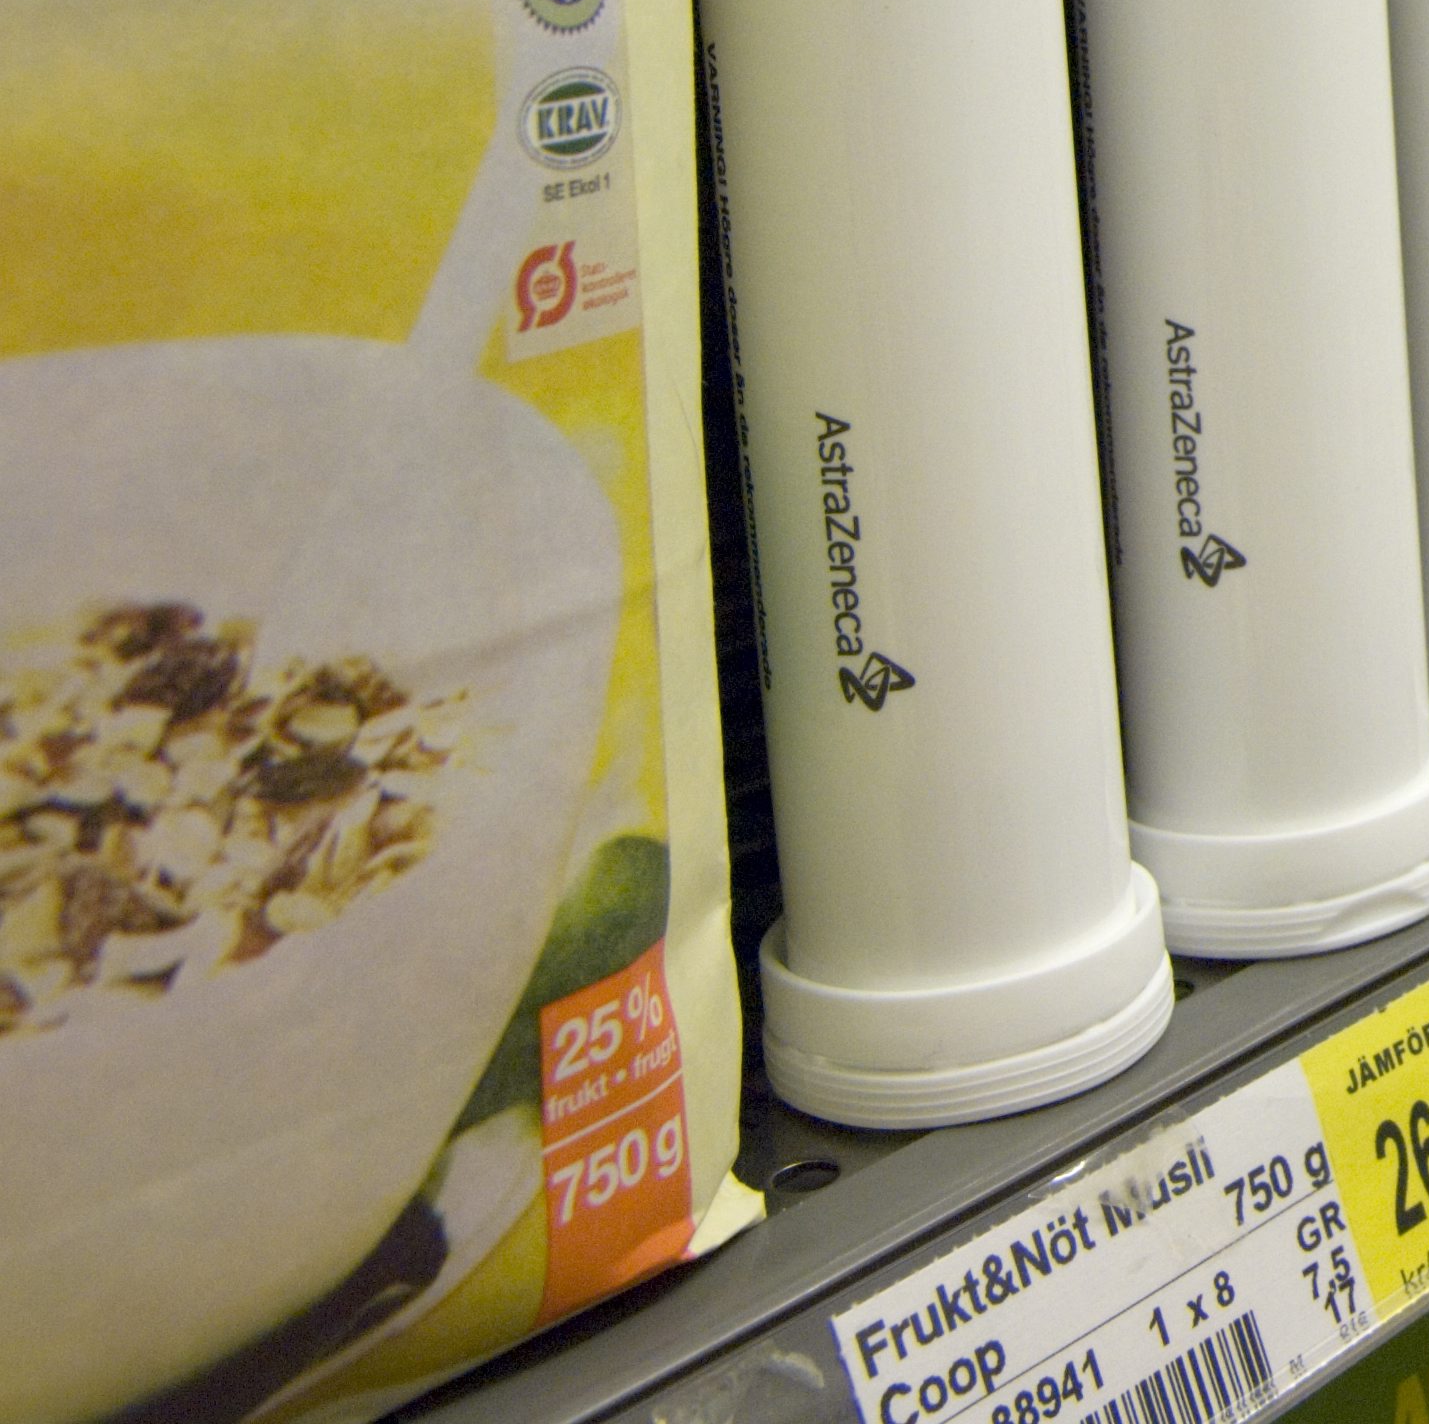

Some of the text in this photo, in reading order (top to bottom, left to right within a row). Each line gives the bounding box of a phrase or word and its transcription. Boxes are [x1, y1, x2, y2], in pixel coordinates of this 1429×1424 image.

[537, 96, 609, 139] KRAV
[543, 182, 566, 203] SE
[569, 175, 600, 197] Ekol
[1165, 319, 1202, 538] AstraZeneca
[814, 410, 863, 657] AstraZeneca
[547, 1030, 678, 1126] frukt frugt
[1224, 1142, 1331, 1227] 750 g
[855, 1206, 1096, 1380] Frukt&Nöt
[880, 1201, 1346, 1424] Coop GR
[1148, 1307, 1172, 1347] 1
[1186, 1294, 1210, 1328] x
[1214, 1271, 1236, 1308] 8
